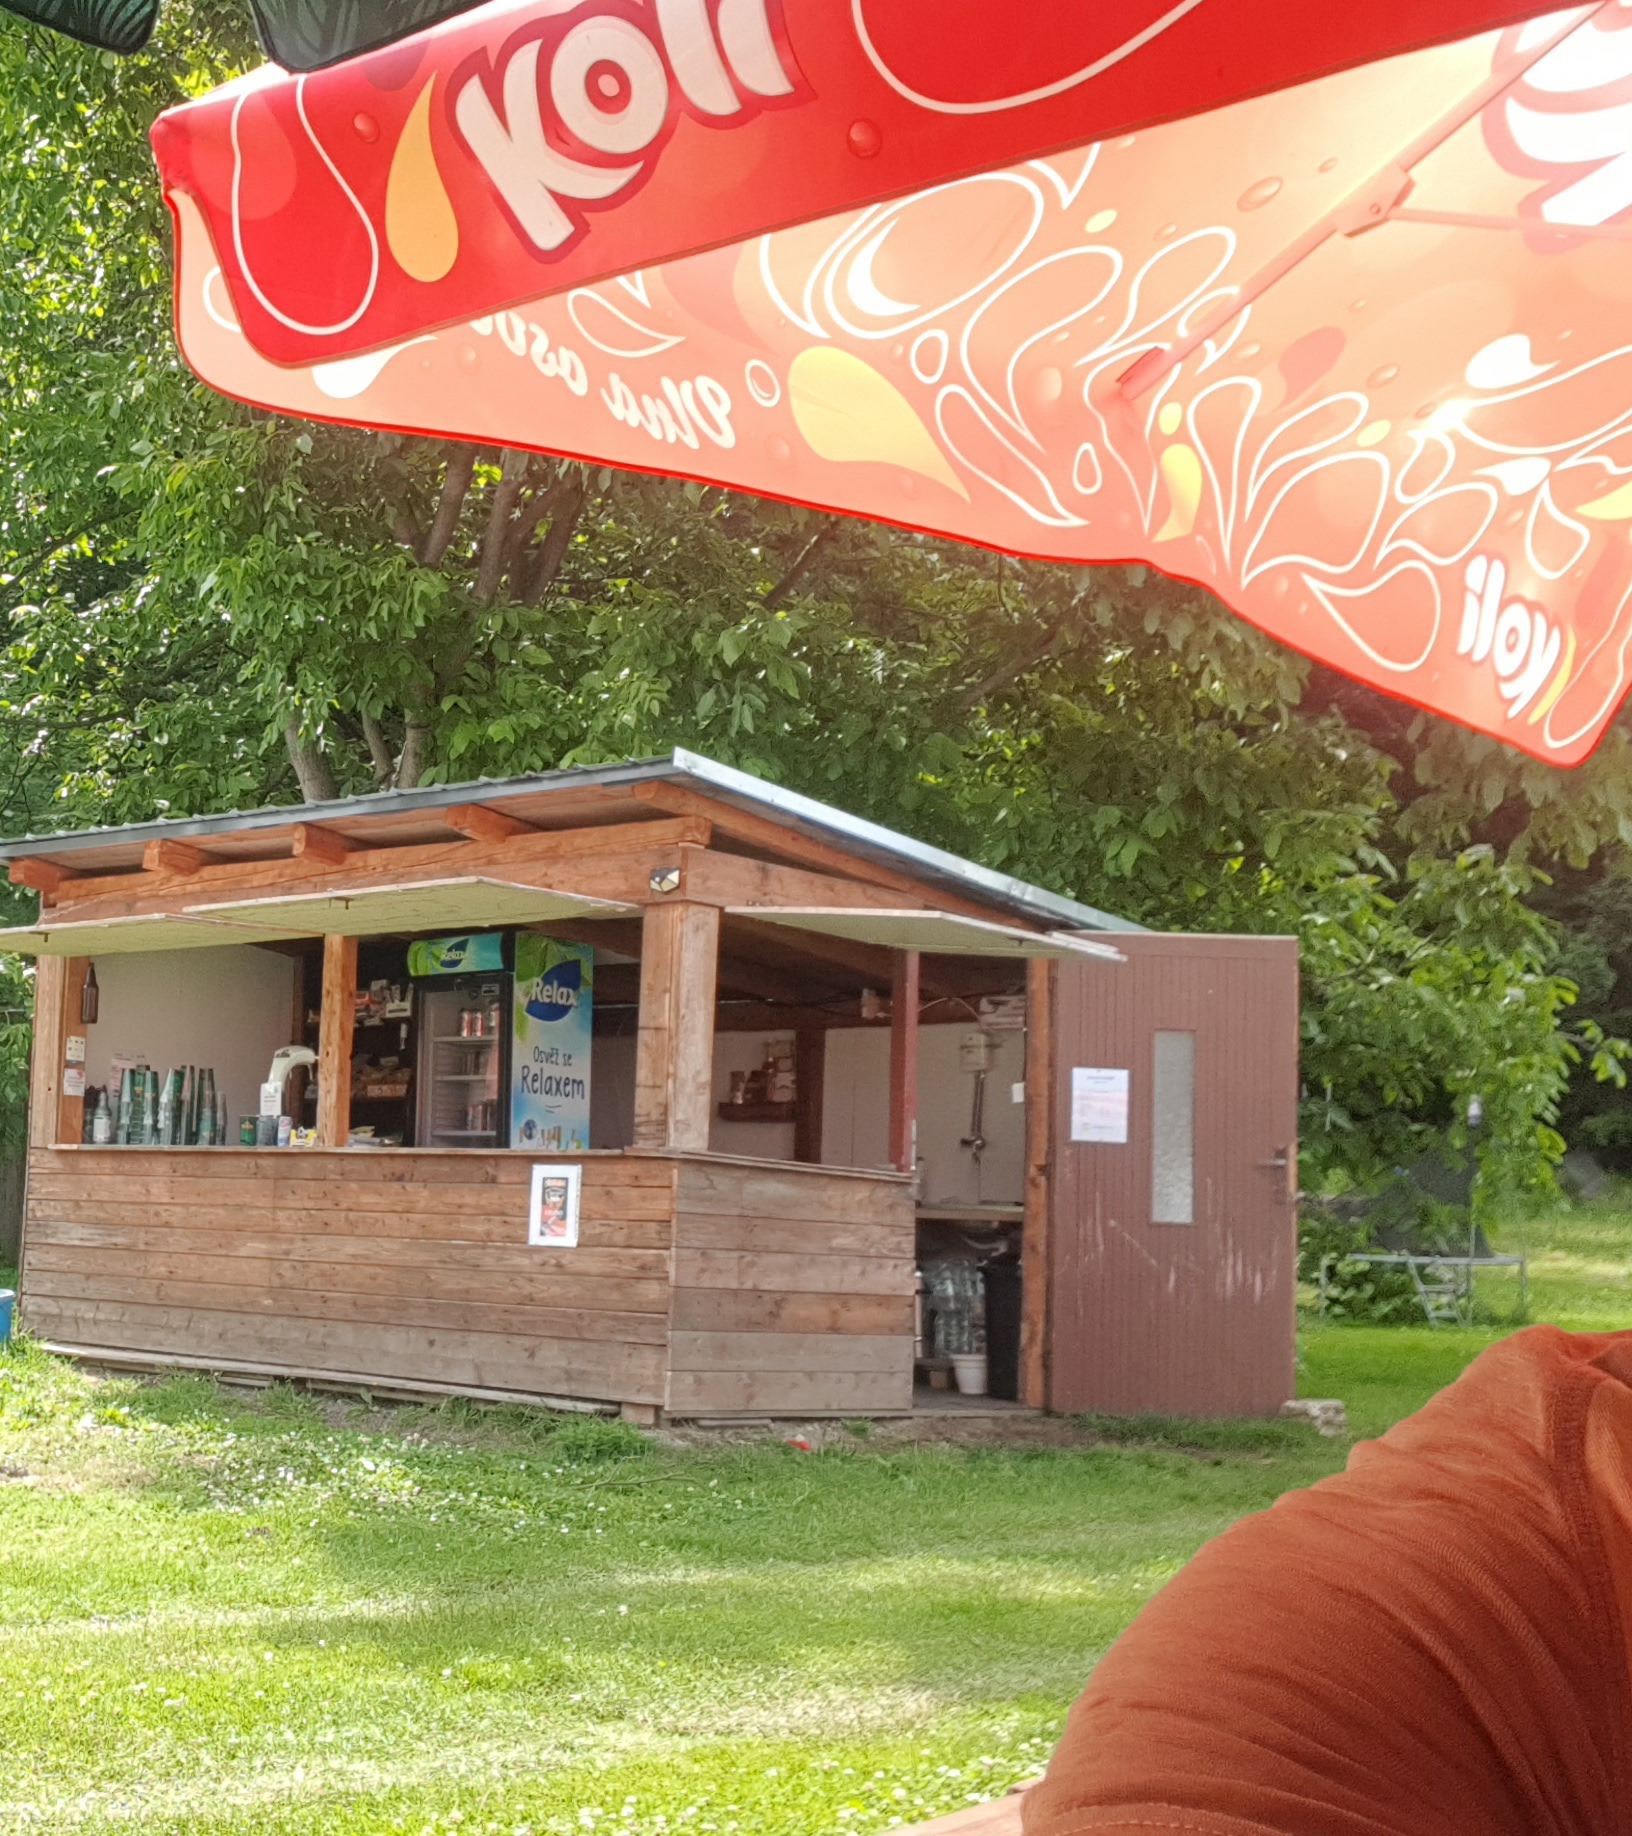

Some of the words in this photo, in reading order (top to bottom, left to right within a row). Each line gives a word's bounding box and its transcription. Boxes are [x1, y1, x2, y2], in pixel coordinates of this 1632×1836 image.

[531, 977, 578, 1007] Relax
[533, 1046, 559, 1066] Osvěž
[562, 1052, 573, 1067] se
[521, 1065, 585, 1100] Relaxem
